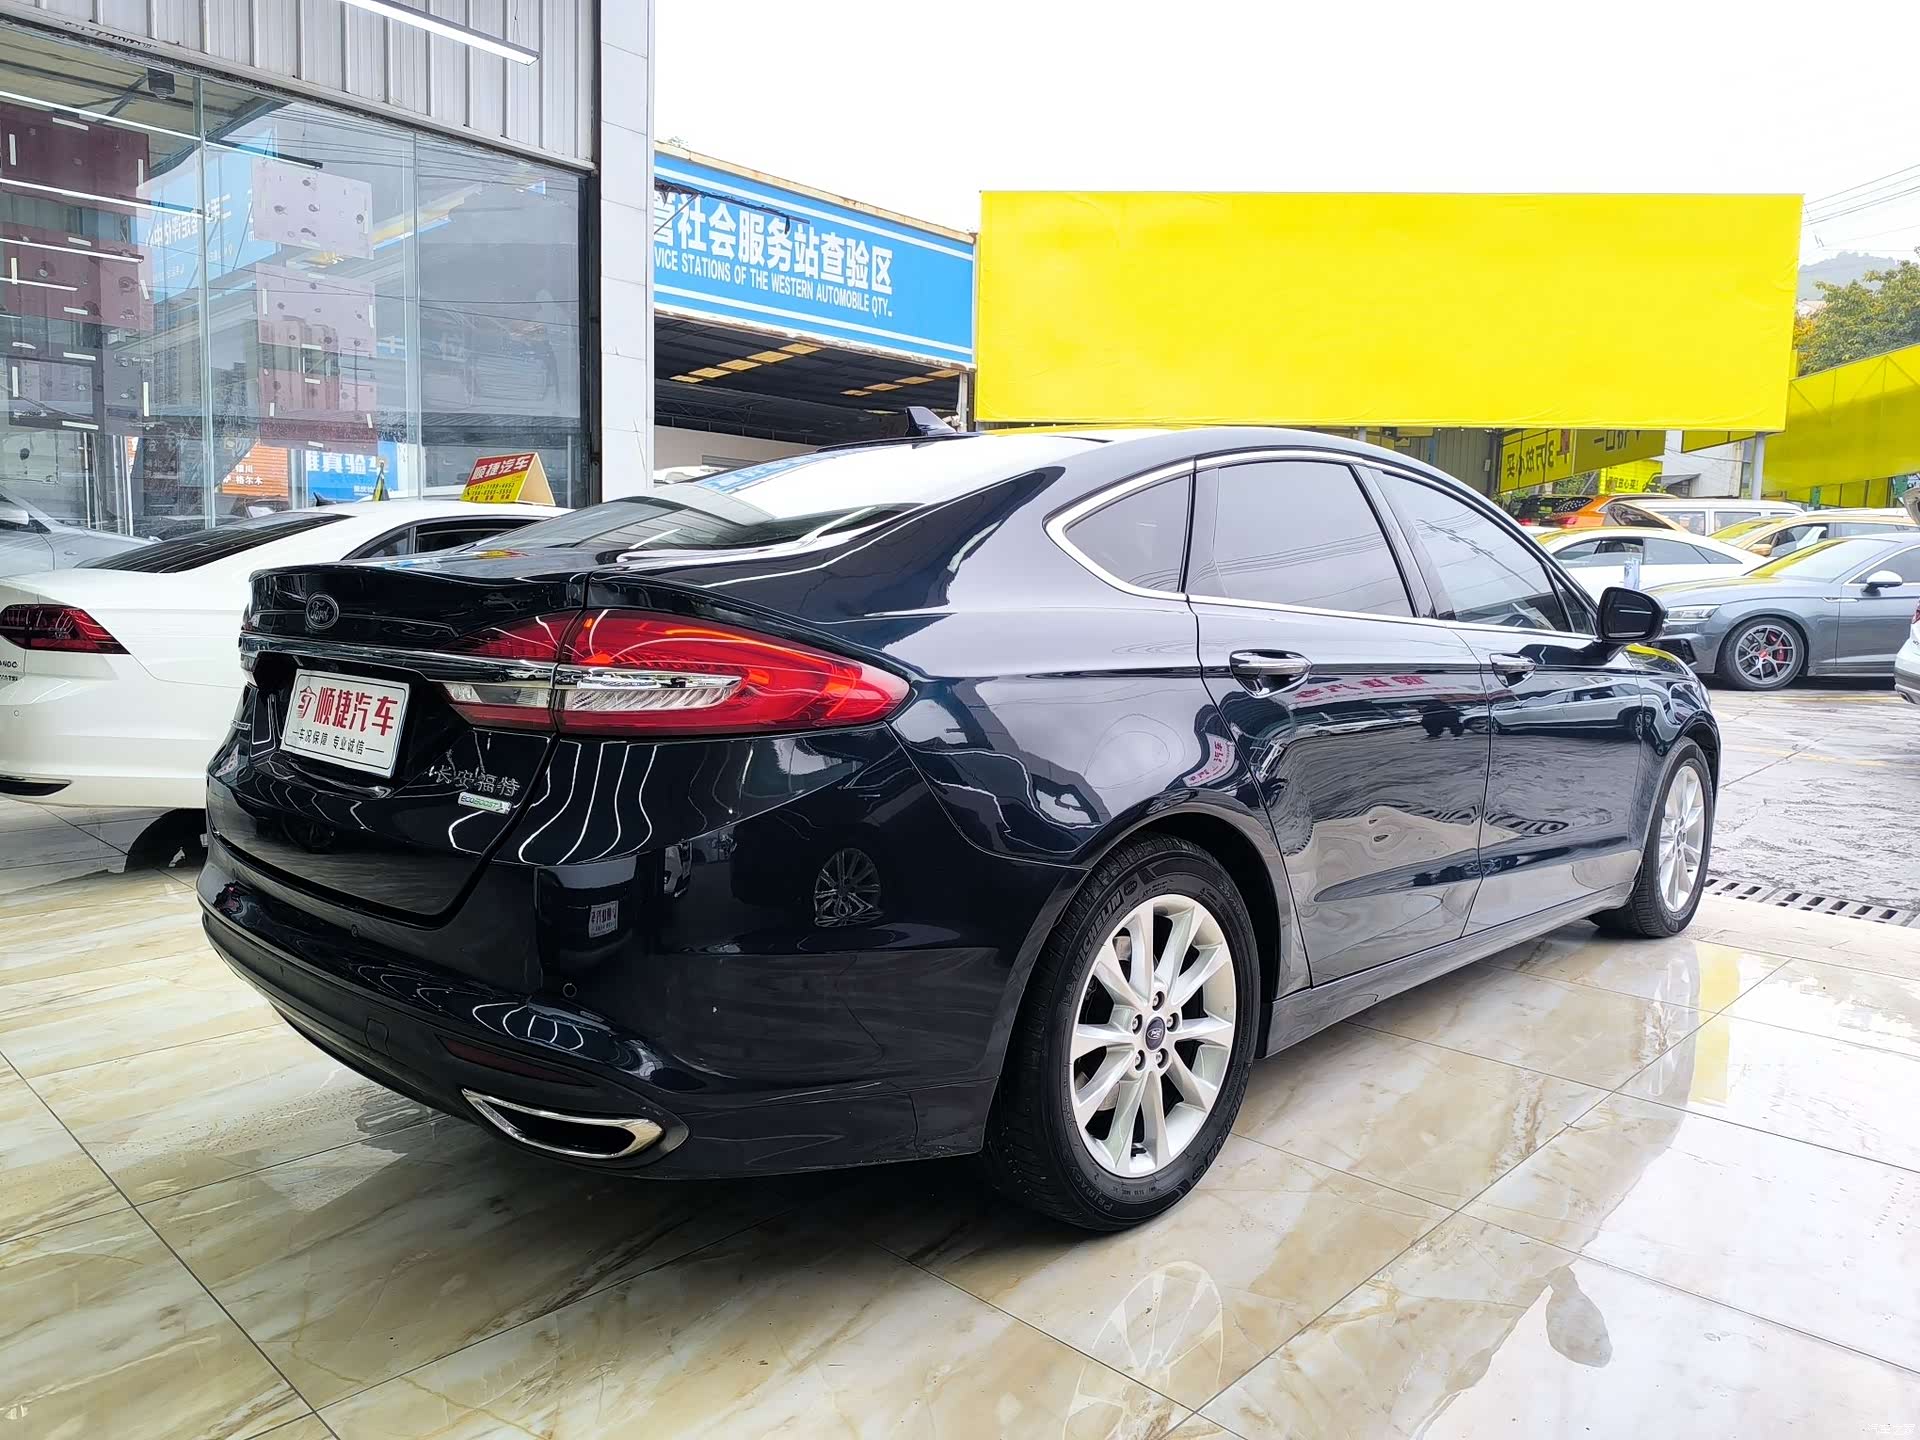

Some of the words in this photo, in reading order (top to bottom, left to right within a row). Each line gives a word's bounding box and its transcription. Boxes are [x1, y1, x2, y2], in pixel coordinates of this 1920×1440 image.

[681, 253, 731, 284] STATIONS
[733, 265, 748, 286] OF
[750, 268, 769, 291] THE
[771, 273, 814, 300] WESTERN
[816, 283, 870, 312] AUTOMOBILE
[313, 686, 398, 737] 顺捷汽车
[298, 728, 329, 746] 车况保障
[333, 735, 365, 755] 专业诚信
[1071, 889, 1124, 978] MICHELIN
